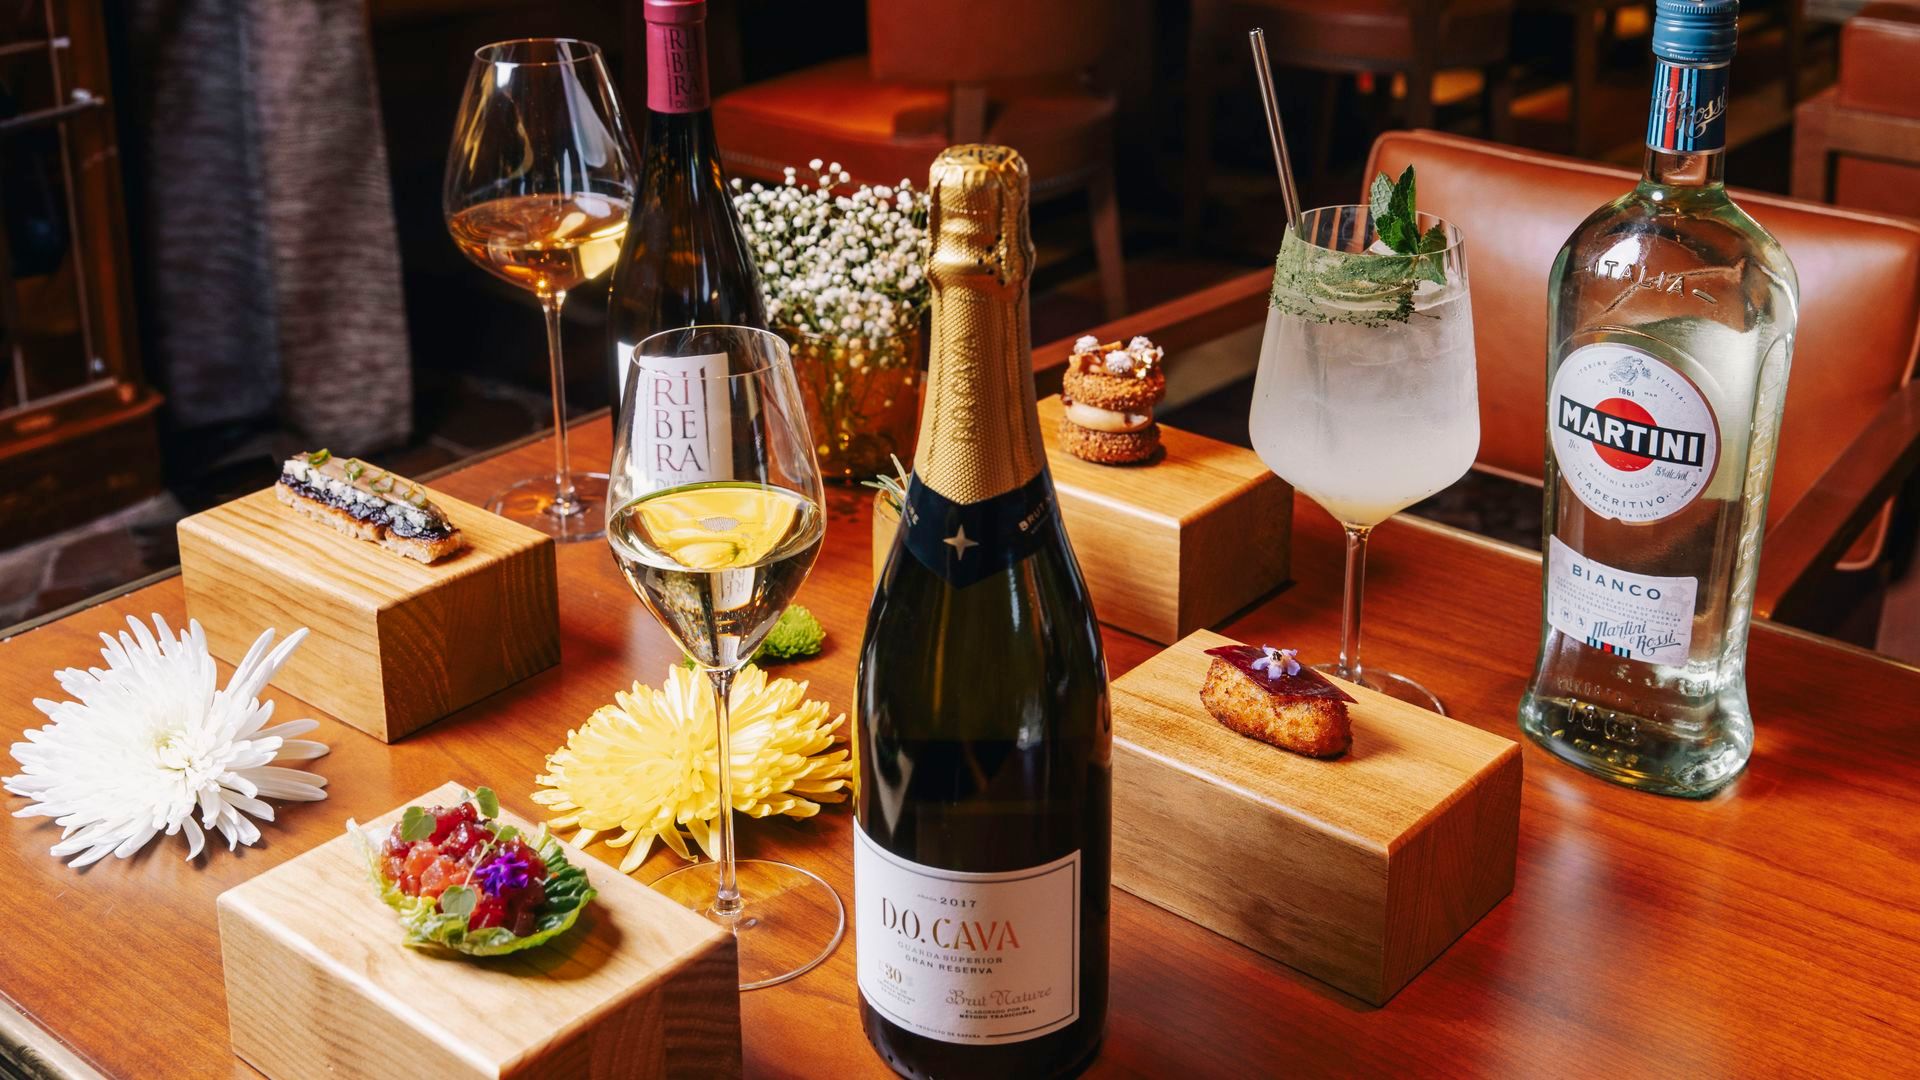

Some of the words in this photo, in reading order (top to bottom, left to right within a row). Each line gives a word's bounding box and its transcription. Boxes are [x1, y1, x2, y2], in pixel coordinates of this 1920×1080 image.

[1595, 260, 1684, 298] ITALIA
[653, 370, 690, 406] RI
[655, 409, 697, 440] BE
[1562, 400, 1699, 463] MARTINI
[656, 443, 704, 472] RA
[1577, 471, 1666, 509] L'APERITIVO
[1571, 563, 1661, 601] BIANCO
[1592, 620, 1647, 640] Martini
[1636, 629, 1682, 656] Rossi
[940, 896, 977, 908] 2017
[882, 896, 926, 944] D.O.
[932, 917, 1021, 951] CAVA
[897, 940, 940, 960] GUARDA
[943, 953, 1004, 964] SUPERIOR
[905, 953, 934, 969] GRAN
[938, 963, 993, 975] RESERVA
[945, 988, 986, 1007] Brut
[990, 987, 1052, 1006] Nature
